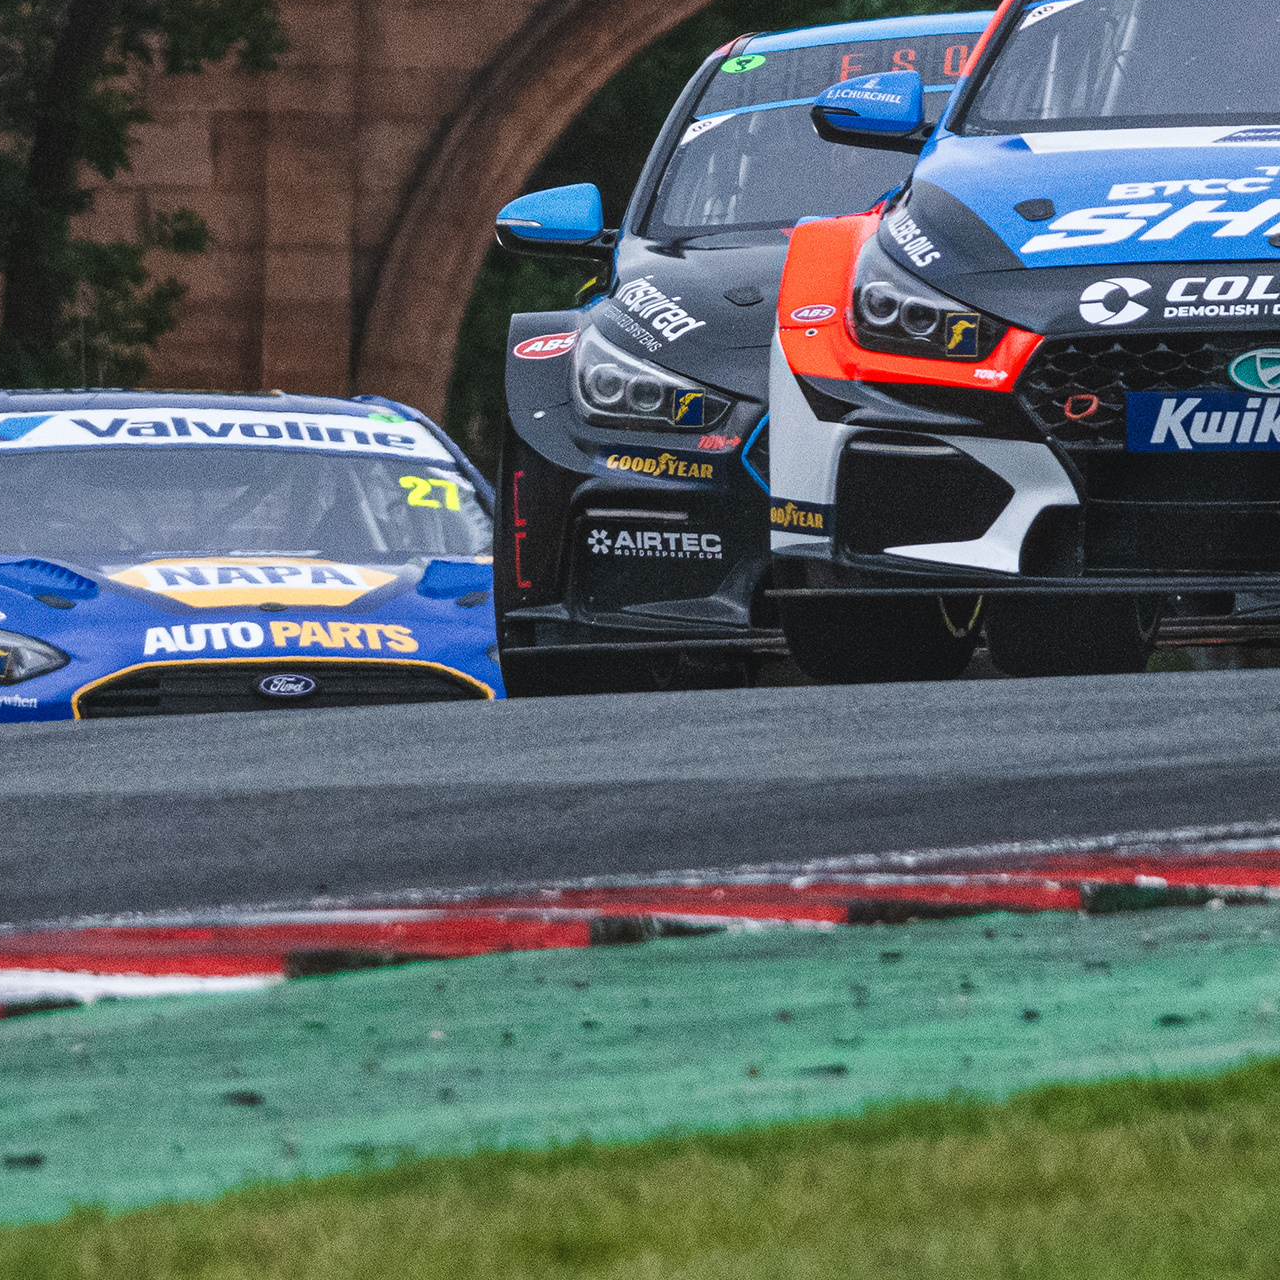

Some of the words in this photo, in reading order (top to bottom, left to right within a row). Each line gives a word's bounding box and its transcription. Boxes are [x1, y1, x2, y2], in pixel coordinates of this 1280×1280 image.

[1106, 177, 1274, 201] BTCC
[904, 236, 941, 267] OILS
[616, 274, 706, 342] inspired
[798, 307, 831, 319] ABS
[1163, 304, 1259, 319] DEMOLISH
[523, 334, 577, 354] ABS
[973, 369, 998, 380] TOW
[69, 416, 416, 451] Valvoline
[606, 453, 713, 479] GOODYEAR
[398, 475, 461, 511] 27
[614, 531, 722, 552] AIRTEC
[614, 549, 723, 559] MOTORSPORT.COM
[156, 565, 359, 587] NAPA
[143, 621, 265, 656] AUTO
[269, 621, 420, 653] PARTS
[269, 676, 307, 693] Ford
